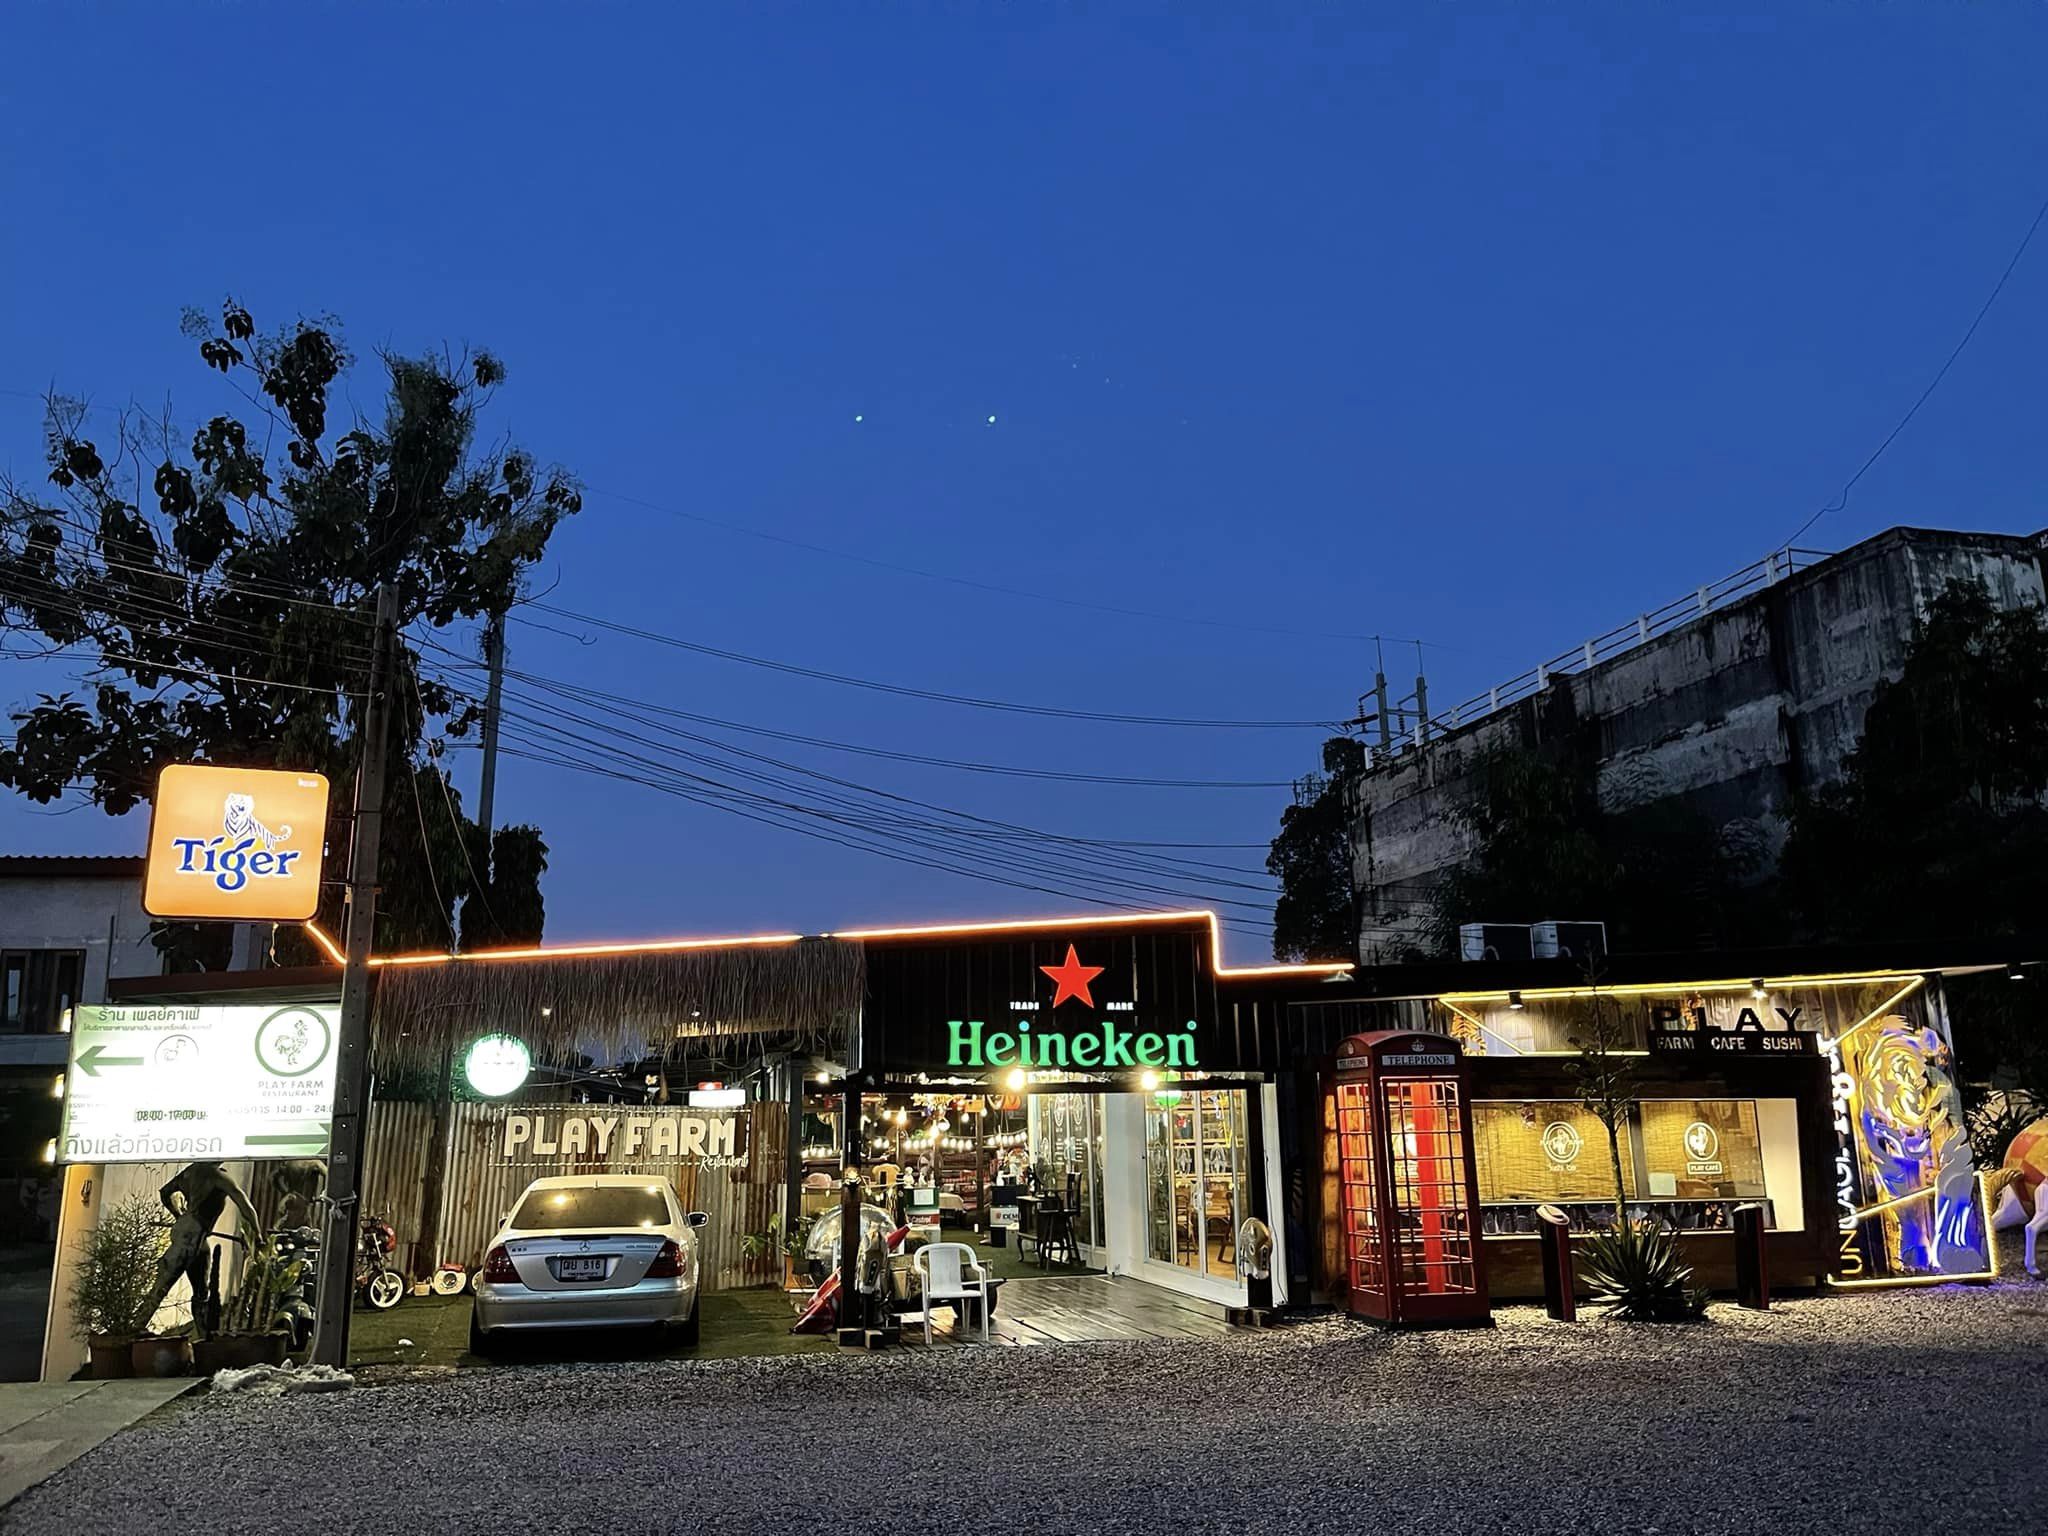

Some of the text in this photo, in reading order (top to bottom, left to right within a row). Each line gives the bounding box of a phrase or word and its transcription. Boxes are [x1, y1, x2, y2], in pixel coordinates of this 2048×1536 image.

[173, 836, 299, 891] Tiger
[1010, 1001, 1134, 1010] TRADE MARK
[98, 1007, 125, 1021] ร้าน
[1652, 1007, 1802, 1032] PLAY
[947, 1020, 1199, 1067] Heineken
[1656, 1037, 1802, 1050] FARM CAFE SUSHI
[1389, 1055, 1449, 1065] TELEPHONE
[258, 1080, 324, 1089] PLAY FARM
[504, 1115, 735, 1157] PLAY FARM
